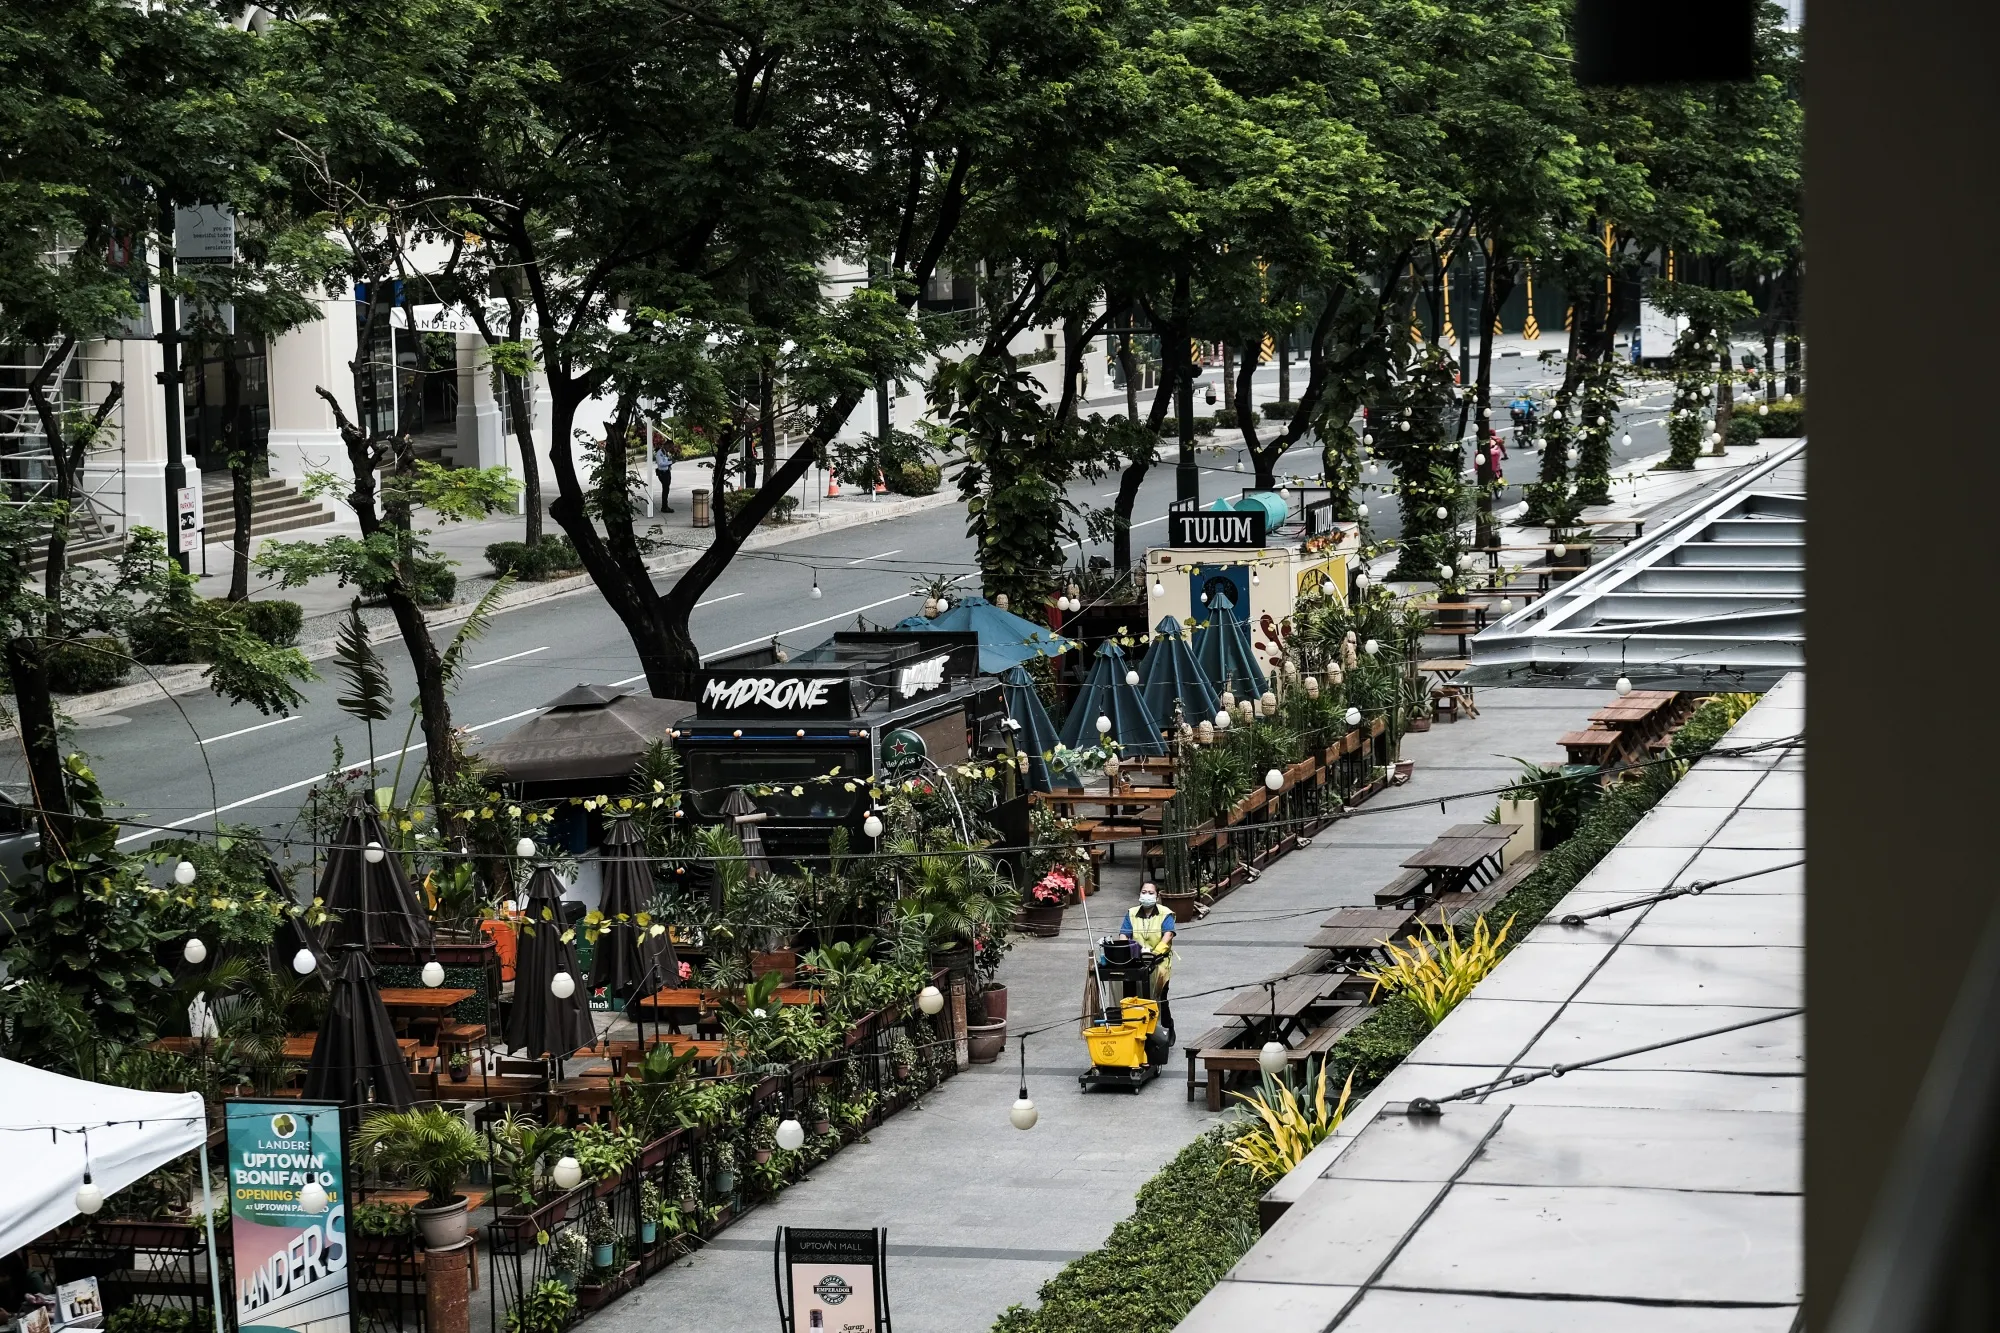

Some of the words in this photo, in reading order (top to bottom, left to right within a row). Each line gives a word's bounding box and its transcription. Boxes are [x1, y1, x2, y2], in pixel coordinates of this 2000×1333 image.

[1180, 517, 1253, 543] TULUM
[702, 677, 844, 710] MADRONE
[258, 1140, 312, 1151] LANDERS
[243, 1153, 324, 1169] UPTOWN
[236, 1189, 293, 1201] OPENING
[254, 1203, 292, 1211] UPTOWN
[800, 1240, 837, 1250] UPTOWN
[840, 1243, 862, 1251] MALL
[241, 1204, 347, 1313] LANDERS
[822, 1276, 843, 1285] COFFEE
[823, 1295, 844, 1303] BRANDY
